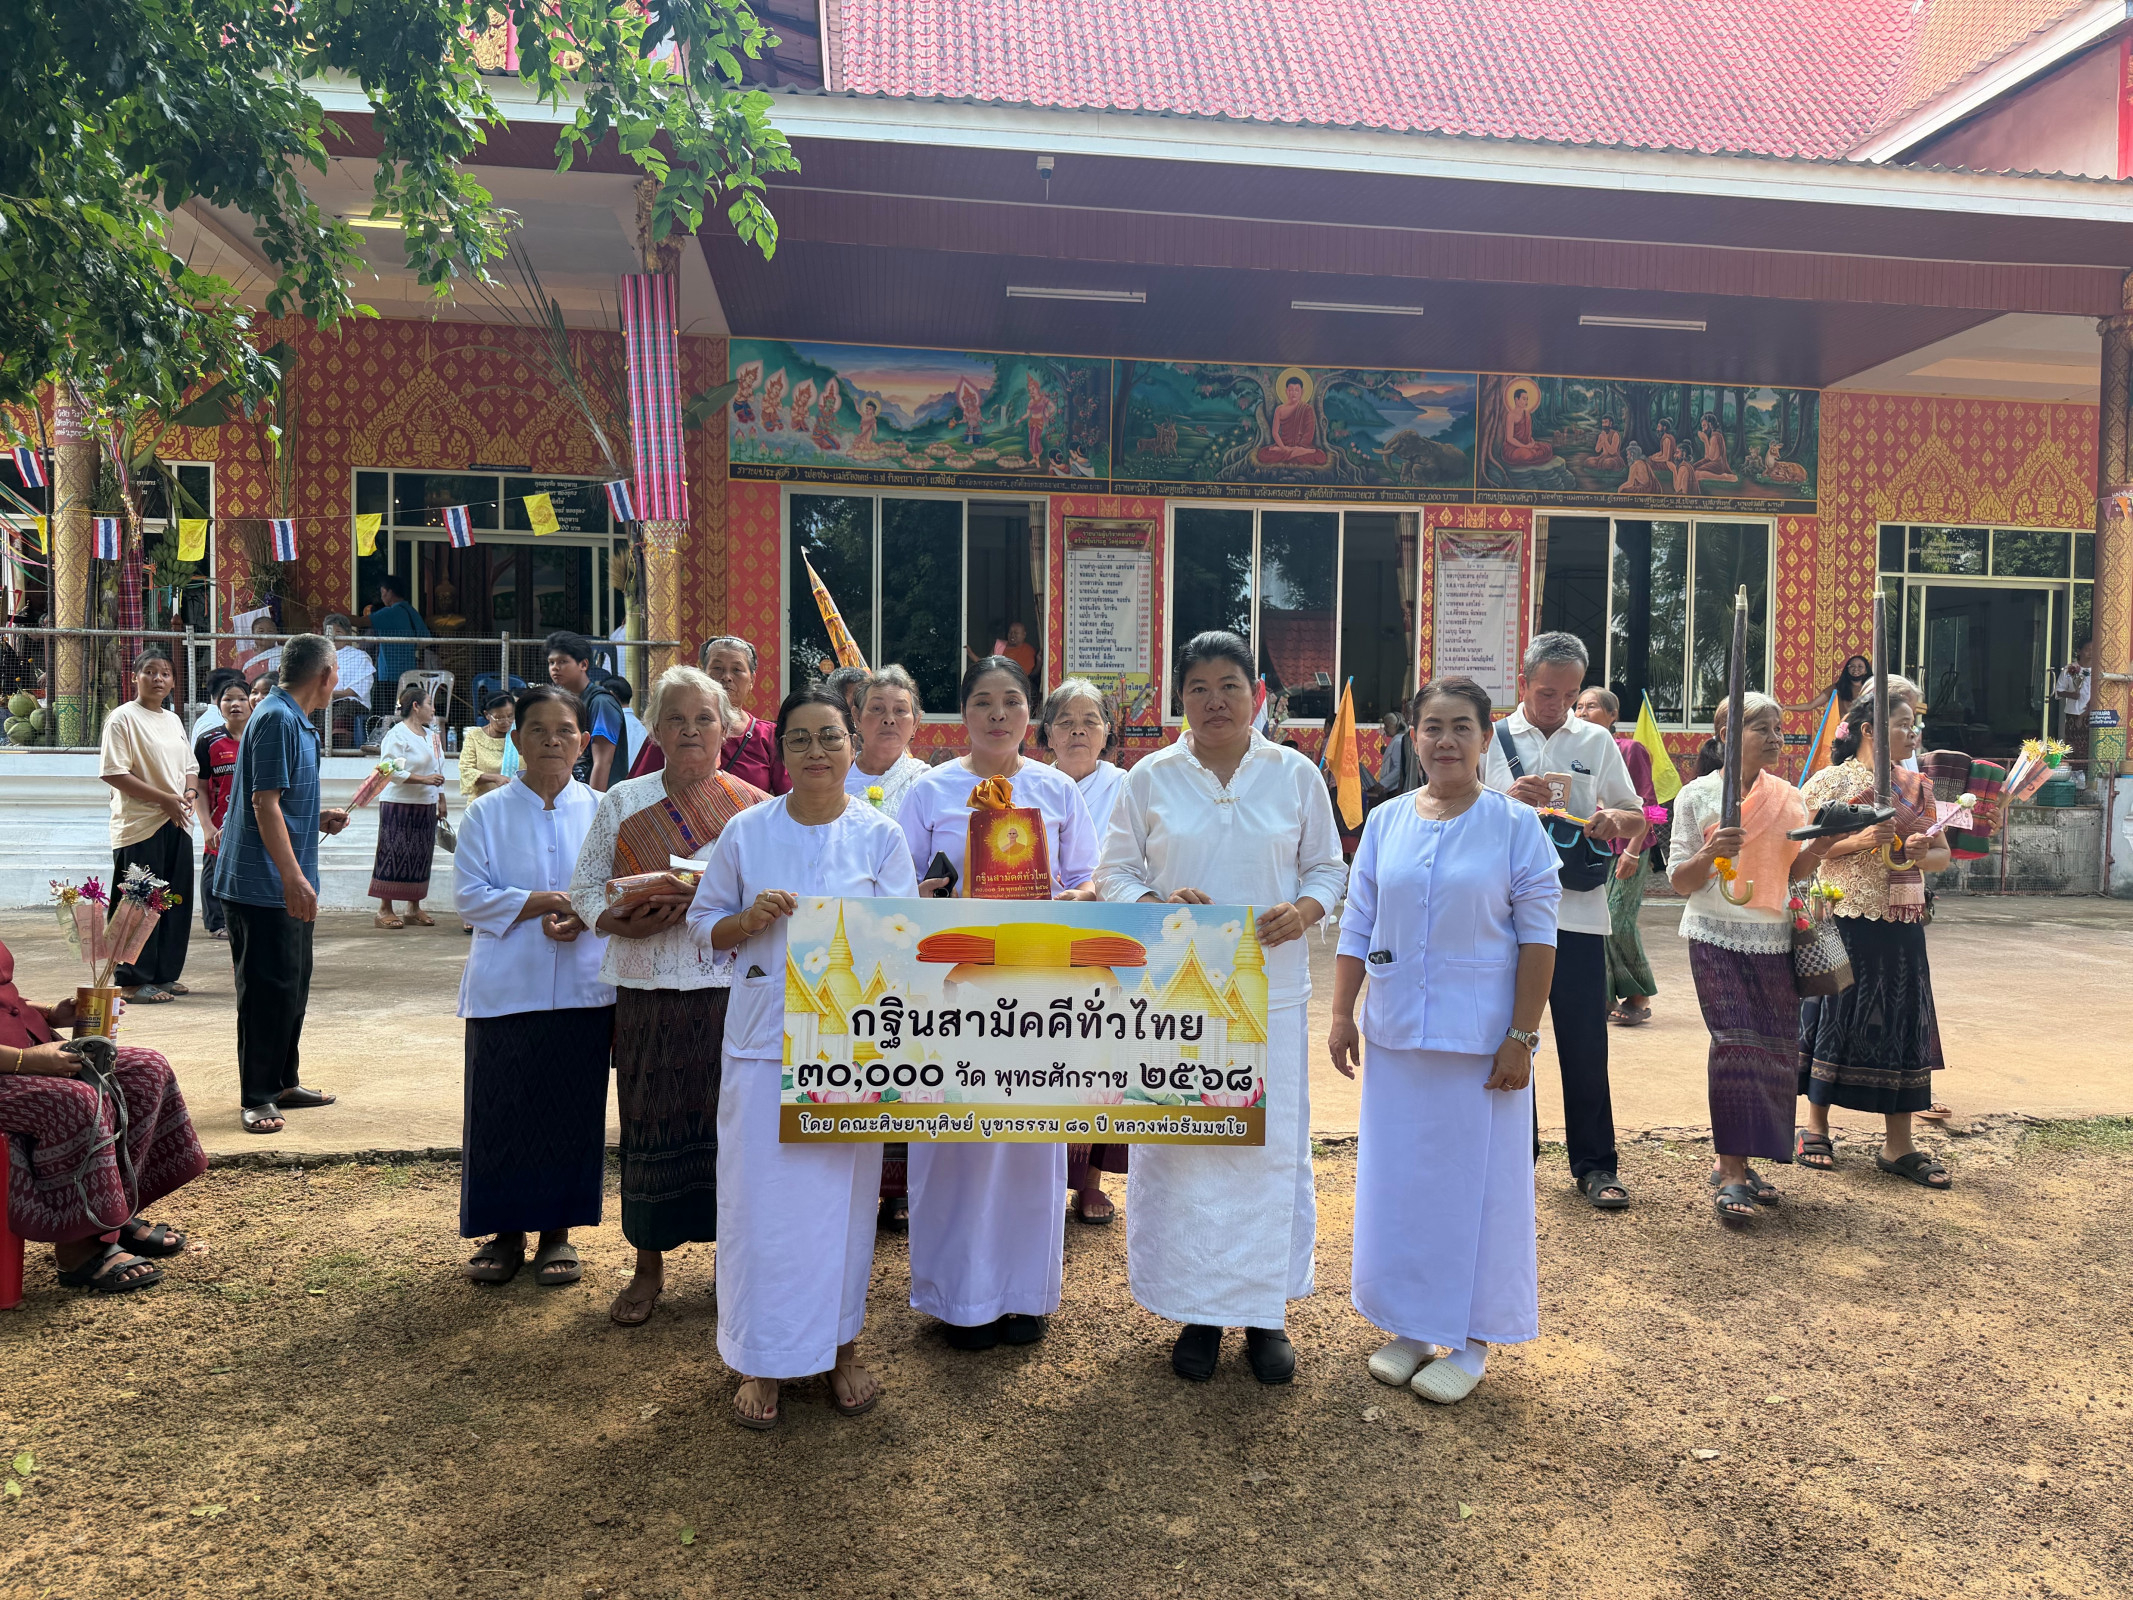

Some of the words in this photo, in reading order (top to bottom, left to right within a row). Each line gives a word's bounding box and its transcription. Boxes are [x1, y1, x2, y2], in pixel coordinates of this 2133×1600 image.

[1418, 493, 1441, 502] 12,000
[1443, 494, 1458, 502] บาท
[975, 868, 1047, 884] กฐินสามัคคีทั่วไทย
[852, 988, 1203, 1049] กฐินสามัคคีทั่วไทย
[798, 1062, 943, 1093] ๓๐,๐๐๐
[955, 1060, 986, 1087] วัด
[995, 1063, 1128, 1097] พุทธศักราช
[1140, 1062, 1253, 1093] ๒๕๖๘
[800, 1114, 832, 1131] โดย
[840, 1114, 974, 1137] คณะศิษยานุศิษย์
[980, 1120, 1059, 1136] บูชาธรรม
[1066, 1119, 1089, 1133] ๘๑
[1096, 1115, 1108, 1132] ปี
[1114, 1117, 1246, 1134] หลวงพ่อธัมมชโย
